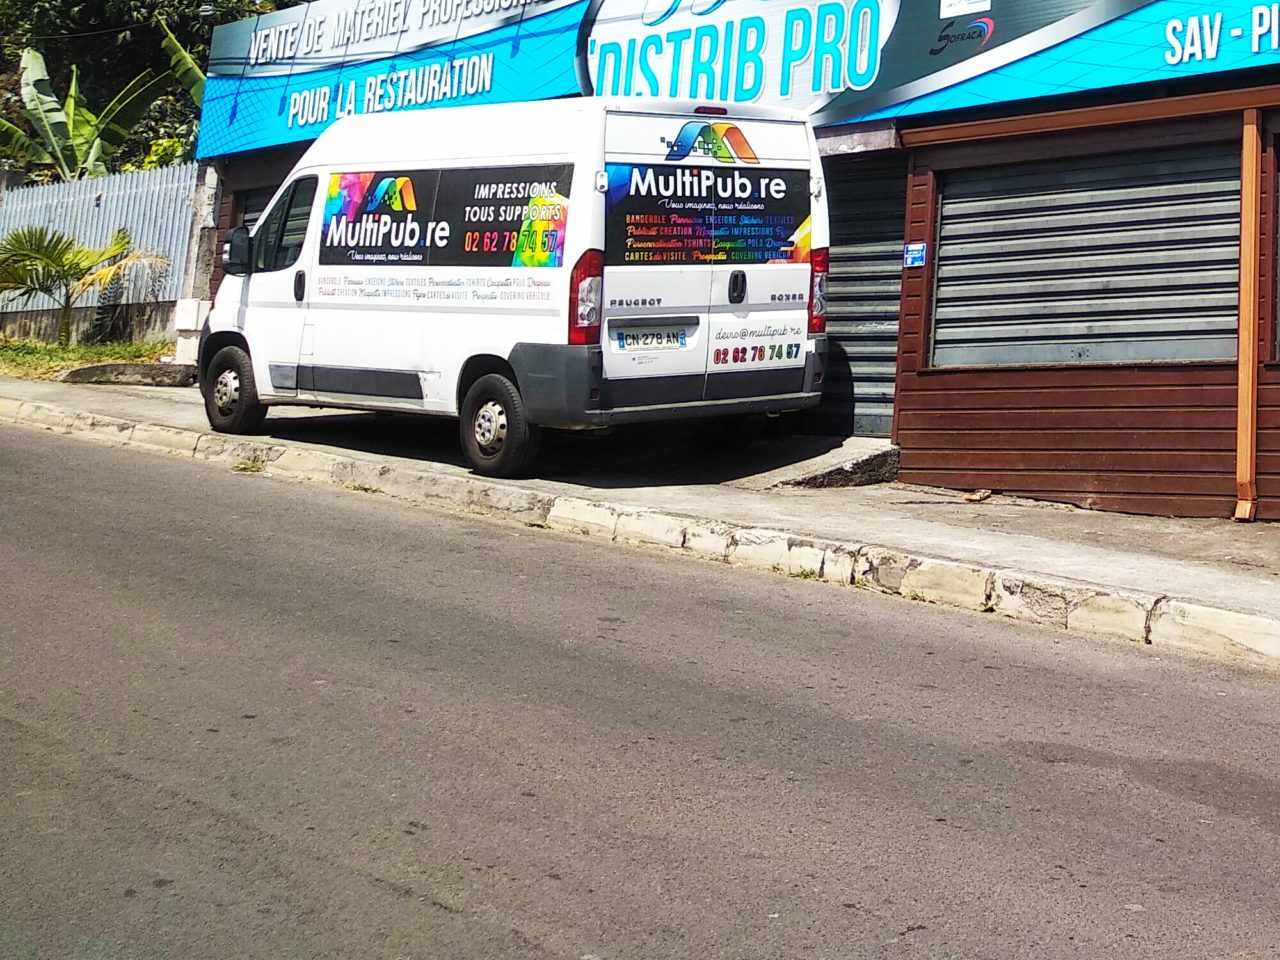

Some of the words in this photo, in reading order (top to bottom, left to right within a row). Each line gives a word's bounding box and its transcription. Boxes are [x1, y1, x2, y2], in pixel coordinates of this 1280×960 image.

[250, 23, 298, 66] VENTE
[303, 15, 325, 55] DE
[1164, 11, 1223, 66] SAV
[1230, 23, 1242, 38] -
[589, 15, 766, 102] DISTRIB
[288, 86, 331, 127] POUR
[335, 81, 356, 118] LA
[363, 52, 495, 113] RESTAURATION
[474, 181, 558, 199] IMPRESSIONS
[464, 206, 495, 222] TOUS
[498, 203, 562, 222] SUPPORTS
[625, 214, 666, 224] BANDEROLE
[705, 215, 737, 224] ENSEIGNE
[326, 212, 450, 247] MultiPub.re
[660, 226, 693, 235] CREATION
[731, 227, 774, 236] IMPRESSIONS
[464, 231, 479, 252] 02
[482, 230, 498, 252] 62
[502, 230, 517, 252] 78
[521, 230, 537, 252] 74
[541, 230, 557, 252] 57
[684, 238, 712, 248] TSHIRTS
[747, 238, 764, 248] POLO
[625, 251, 653, 261] CARTES
[663, 251, 687, 261] VISITE
[731, 251, 763, 260] COVERING
[610, 298, 662, 307] PEUGEOT
[771, 293, 804, 301] BOXER
[625, 331, 679, 346] CN-278-AN
[713, 347, 729, 364] 02
[732, 346, 747, 363] 62
[751, 345, 765, 361] 78
[769, 344, 783, 360] 74
[786, 343, 801, 359] 57
